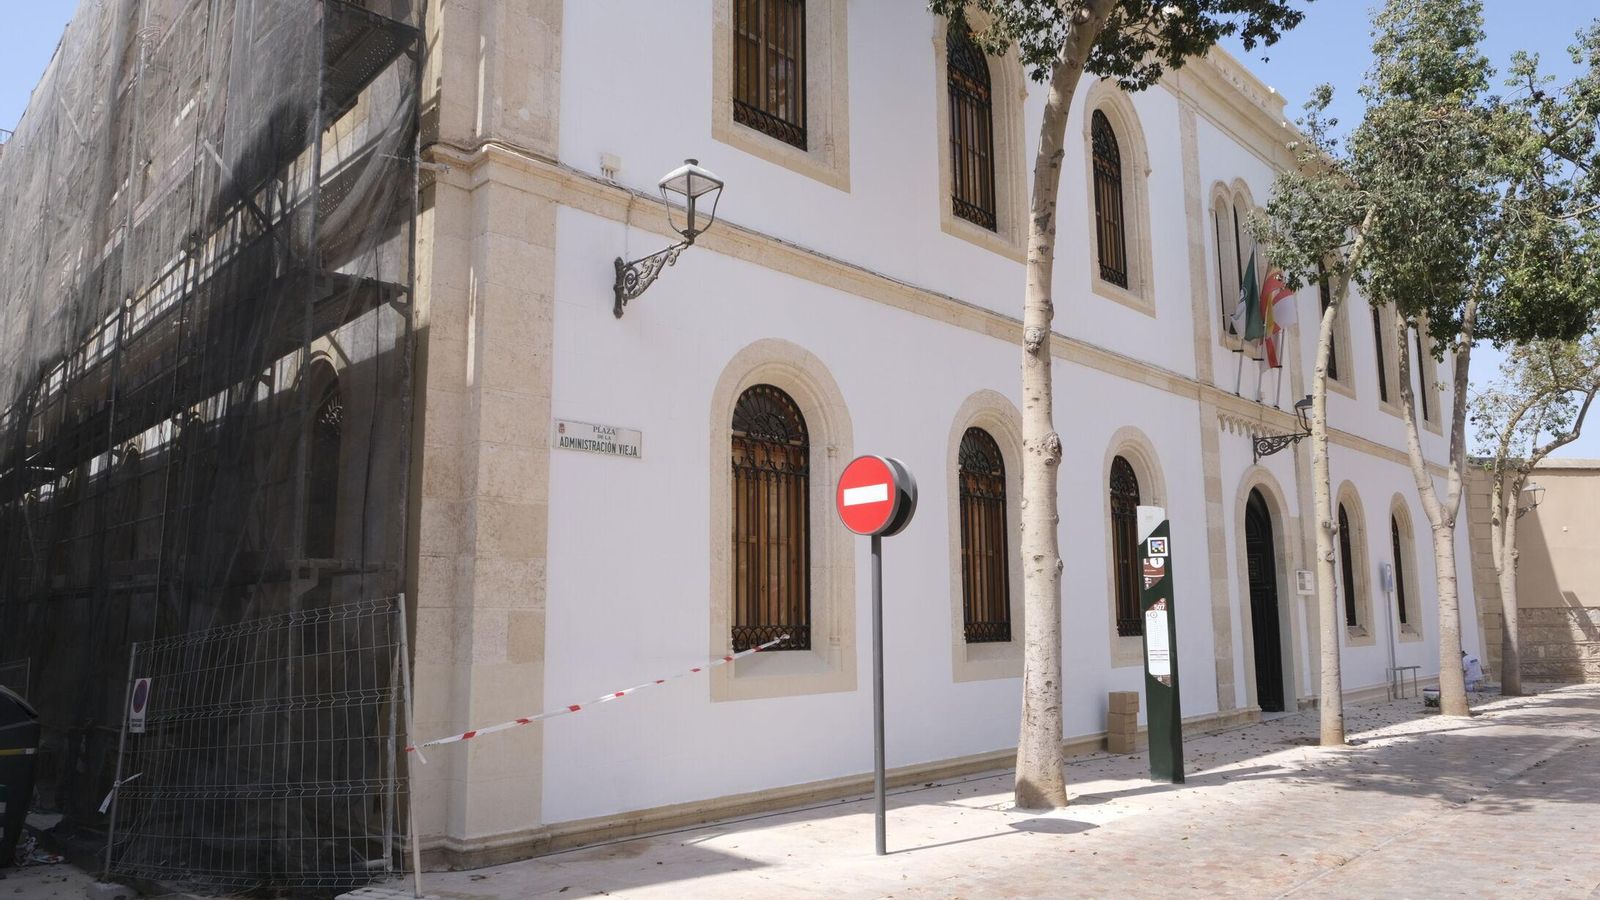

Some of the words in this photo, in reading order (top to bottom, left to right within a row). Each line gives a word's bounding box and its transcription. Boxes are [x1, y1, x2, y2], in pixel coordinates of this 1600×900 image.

[593, 426, 616, 435] PLAZA
[560, 436, 617, 454] ADMINISTRACIÓN
[619, 444, 638, 456] VIEJA
